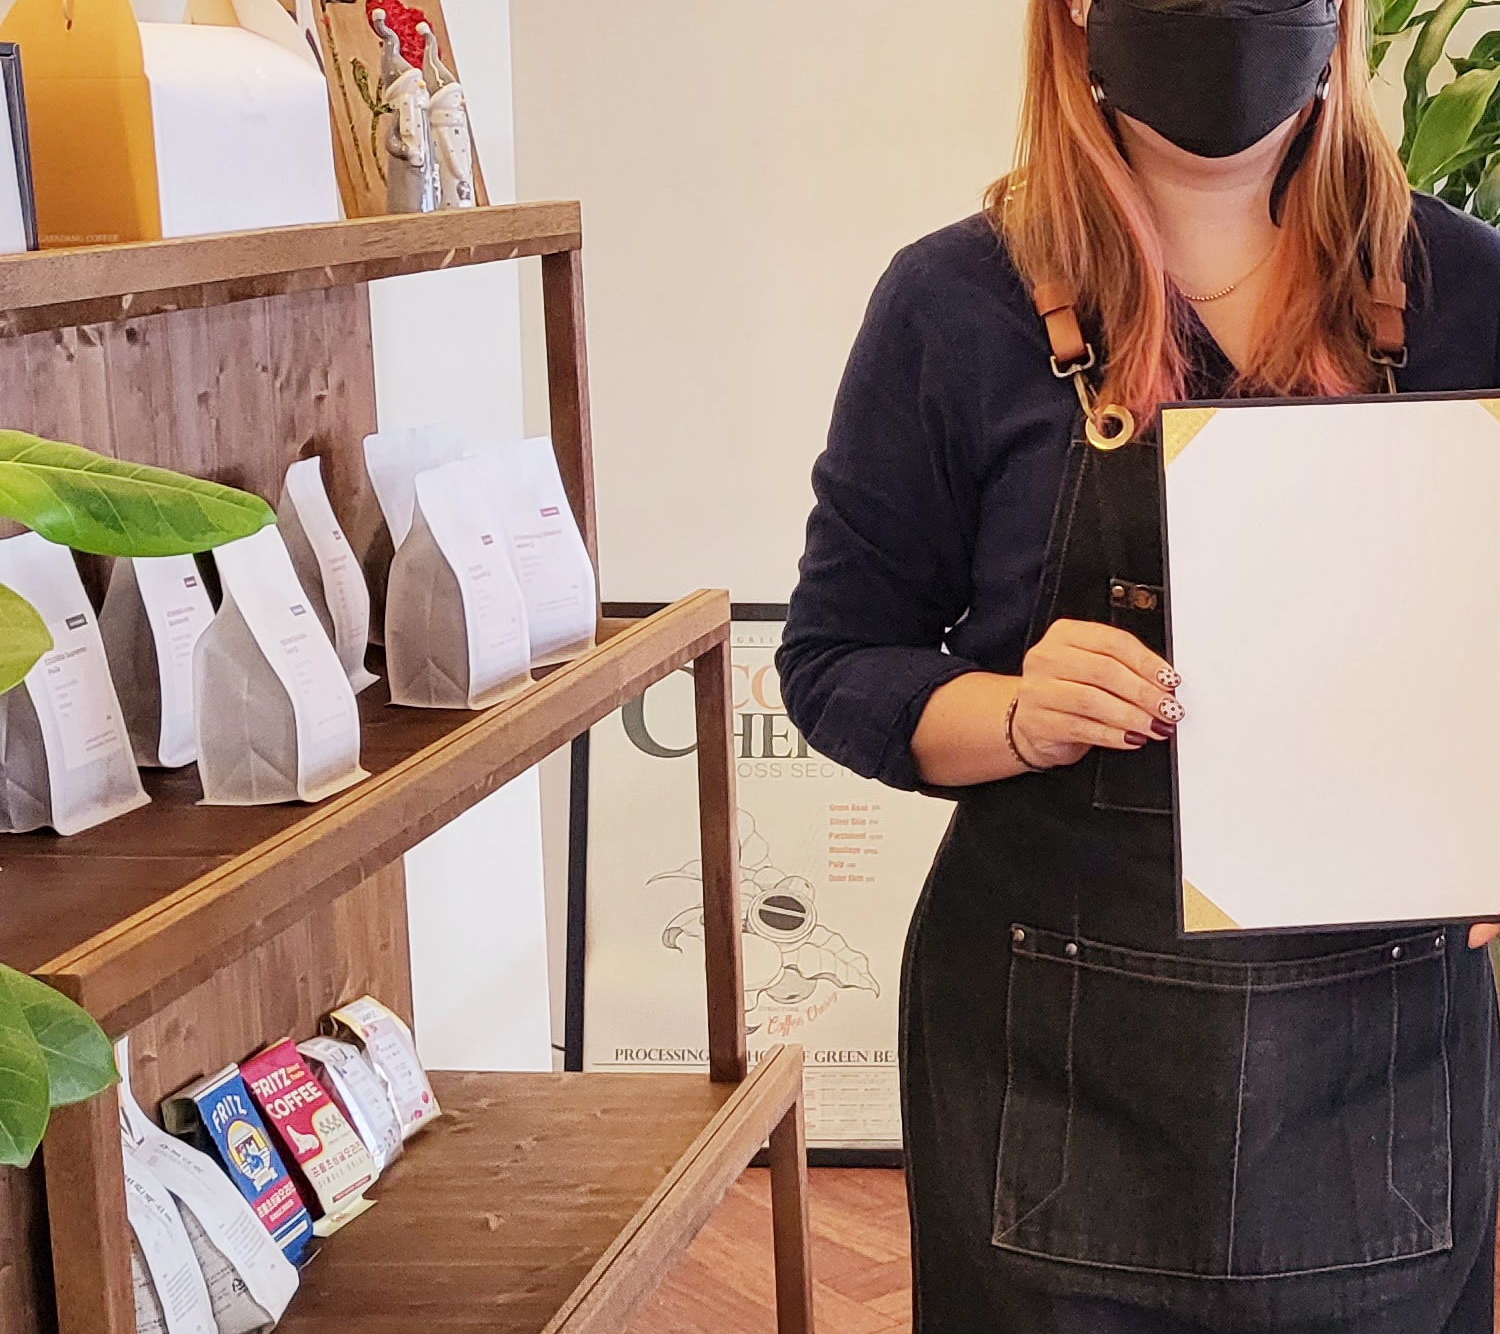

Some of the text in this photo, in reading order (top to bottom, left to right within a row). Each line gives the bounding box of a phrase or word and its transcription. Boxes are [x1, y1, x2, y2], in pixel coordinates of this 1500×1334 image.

[767, 1014, 804, 1037] Coffee
[615, 1047, 710, 1062] PROCESSING
[814, 1050, 868, 1063] GREEN
[251, 1067, 291, 1098] FRITZ
[211, 1095, 247, 1134] FRITZ
[266, 1081, 322, 1120] COFFEE
